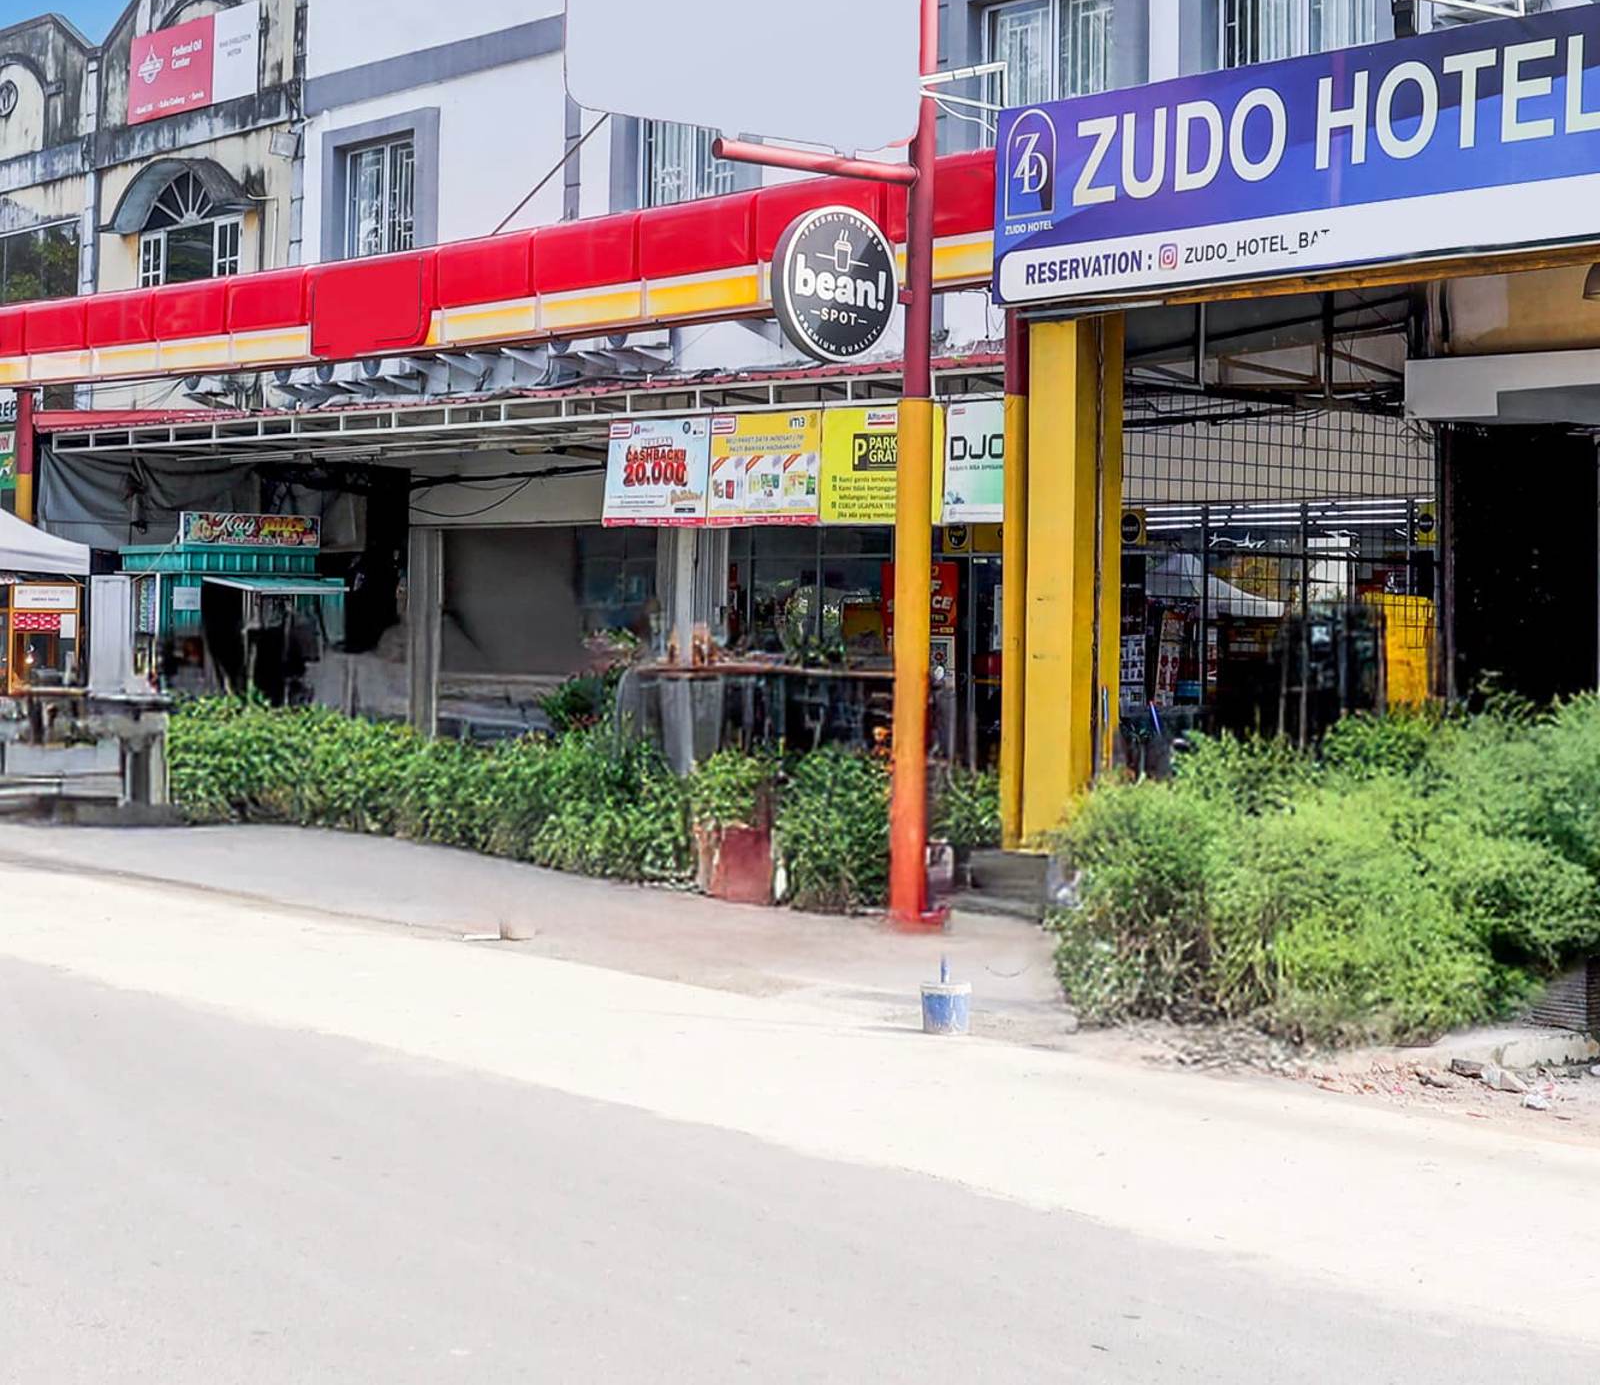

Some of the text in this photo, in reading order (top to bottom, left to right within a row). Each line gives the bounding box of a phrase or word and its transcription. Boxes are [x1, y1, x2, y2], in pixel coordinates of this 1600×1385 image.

[171, 57, 191, 69] Center
[1072, 34, 1600, 207] ZUDO HOTEL
[804, 214, 883, 251] FRESHLY BREWED
[1004, 220, 1054, 236] ZUDO HOTEL
[1025, 249, 1143, 286] RESERVATION
[795, 253, 887, 312] bean!
[820, 307, 858, 326] SPOT
[799, 314, 879, 355] PREMIUM QUALITY
[854, 438, 868, 465] P
[869, 436, 897, 450] PARK
[869, 450, 897, 463] GRAT
[623, 460, 688, 488] 20.000
